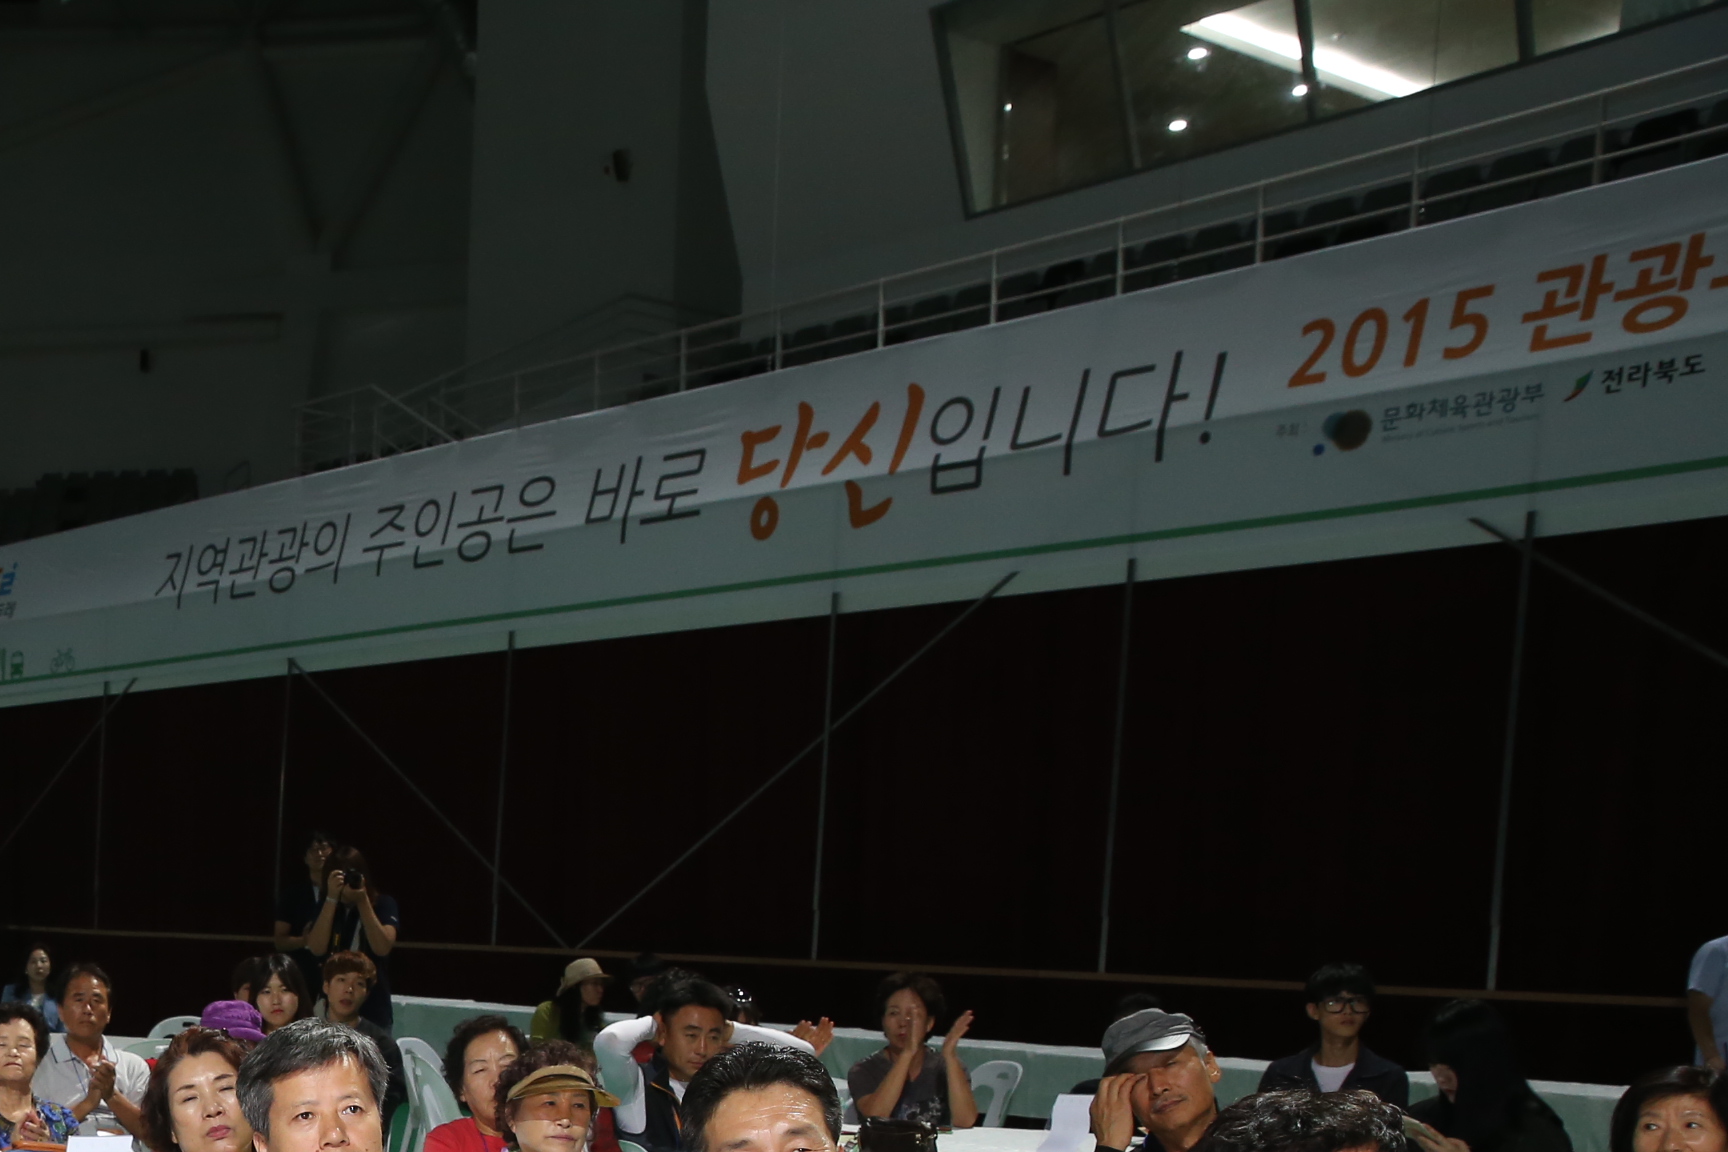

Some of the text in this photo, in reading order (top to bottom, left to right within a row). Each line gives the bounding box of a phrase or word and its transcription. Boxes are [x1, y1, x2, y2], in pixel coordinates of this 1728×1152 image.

[1287, 231, 1728, 388] 2015 관광
[1380, 382, 1545, 432] 문화체육관광부
[1600, 353, 1706, 395] 전라북도
[155, 513, 352, 609] 지역관광의
[363, 476, 556, 576] 주인공은
[585, 448, 706, 544] 바로
